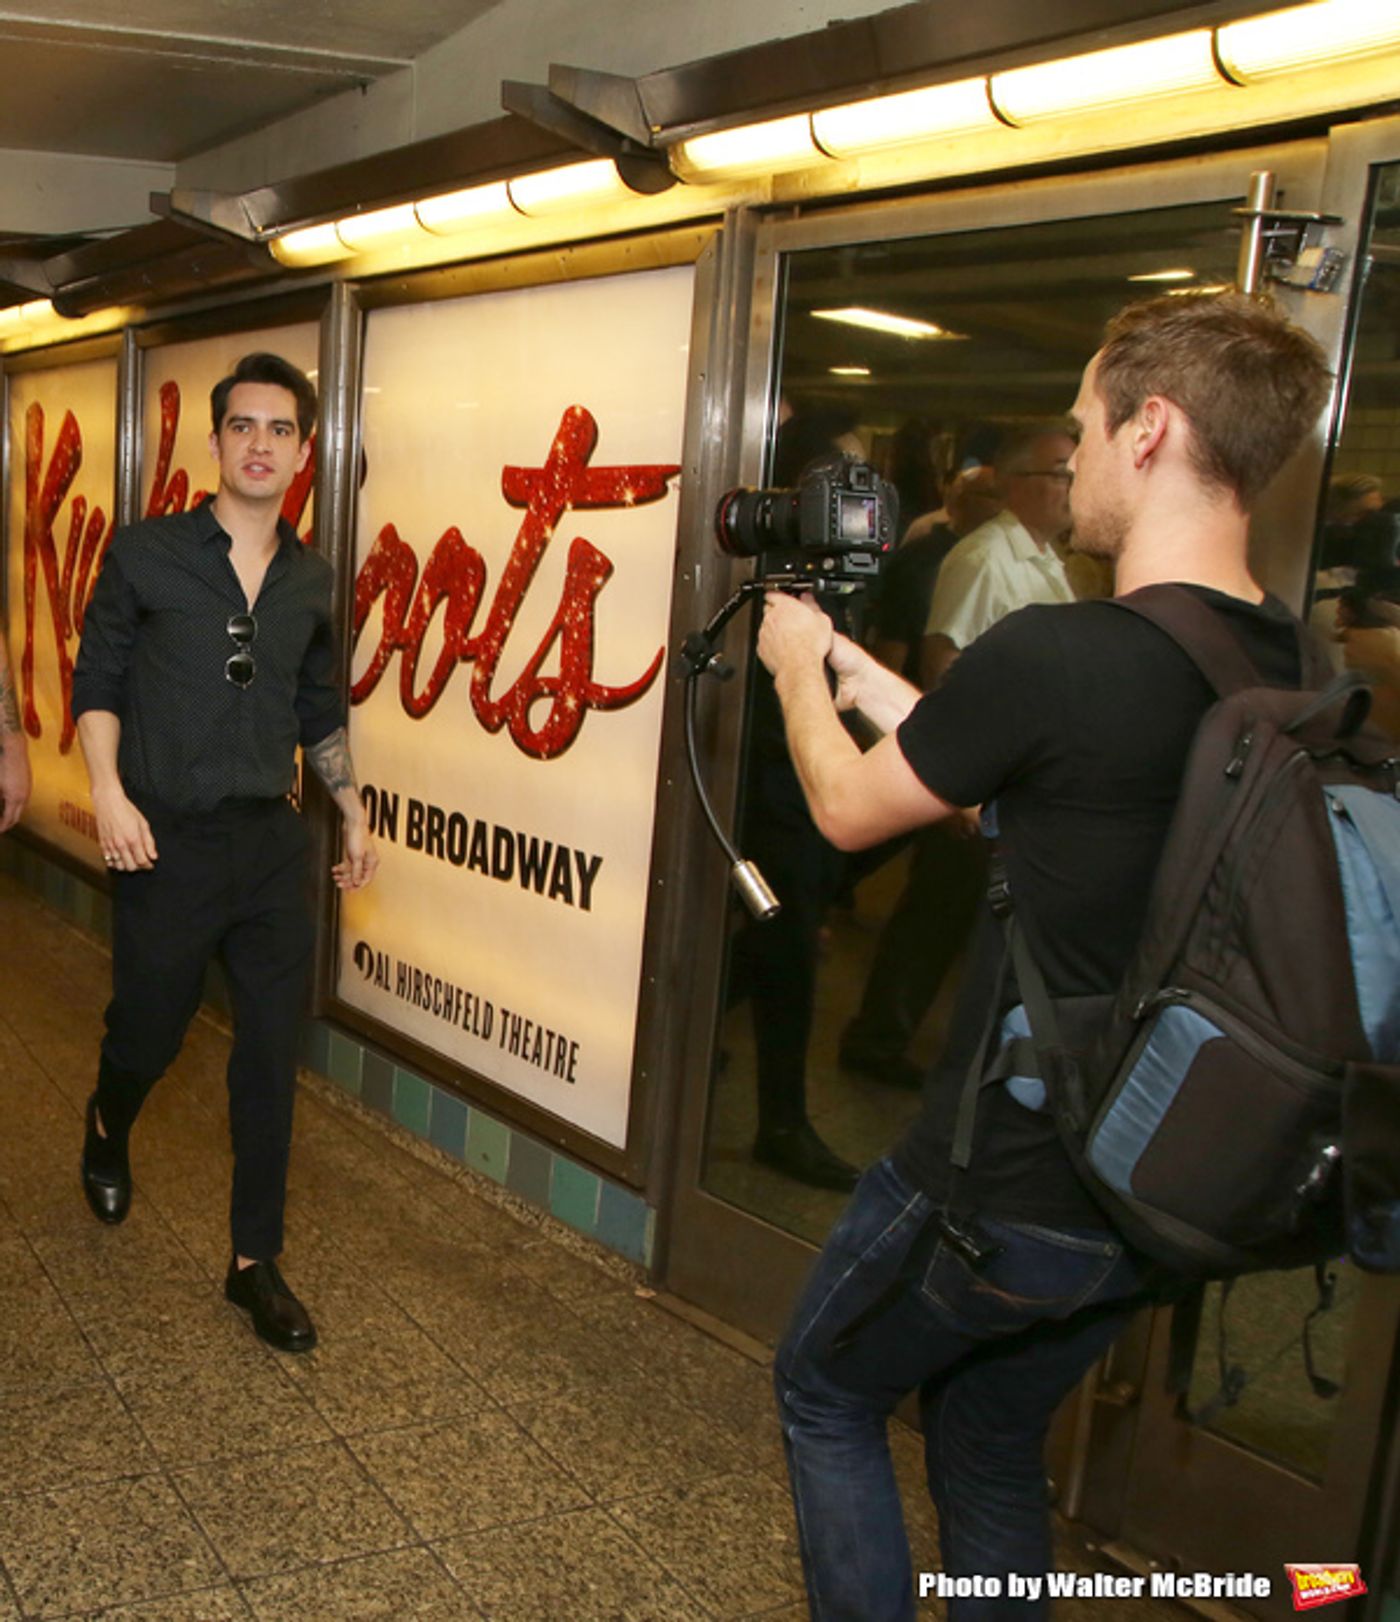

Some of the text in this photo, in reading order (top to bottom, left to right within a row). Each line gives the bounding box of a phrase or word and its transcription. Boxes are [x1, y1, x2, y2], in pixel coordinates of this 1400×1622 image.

[281, 403, 682, 761] oots
[406, 798, 604, 912] BROADWAY
[373, 951, 581, 1084] AL HIRSCHFELD THEATRE
